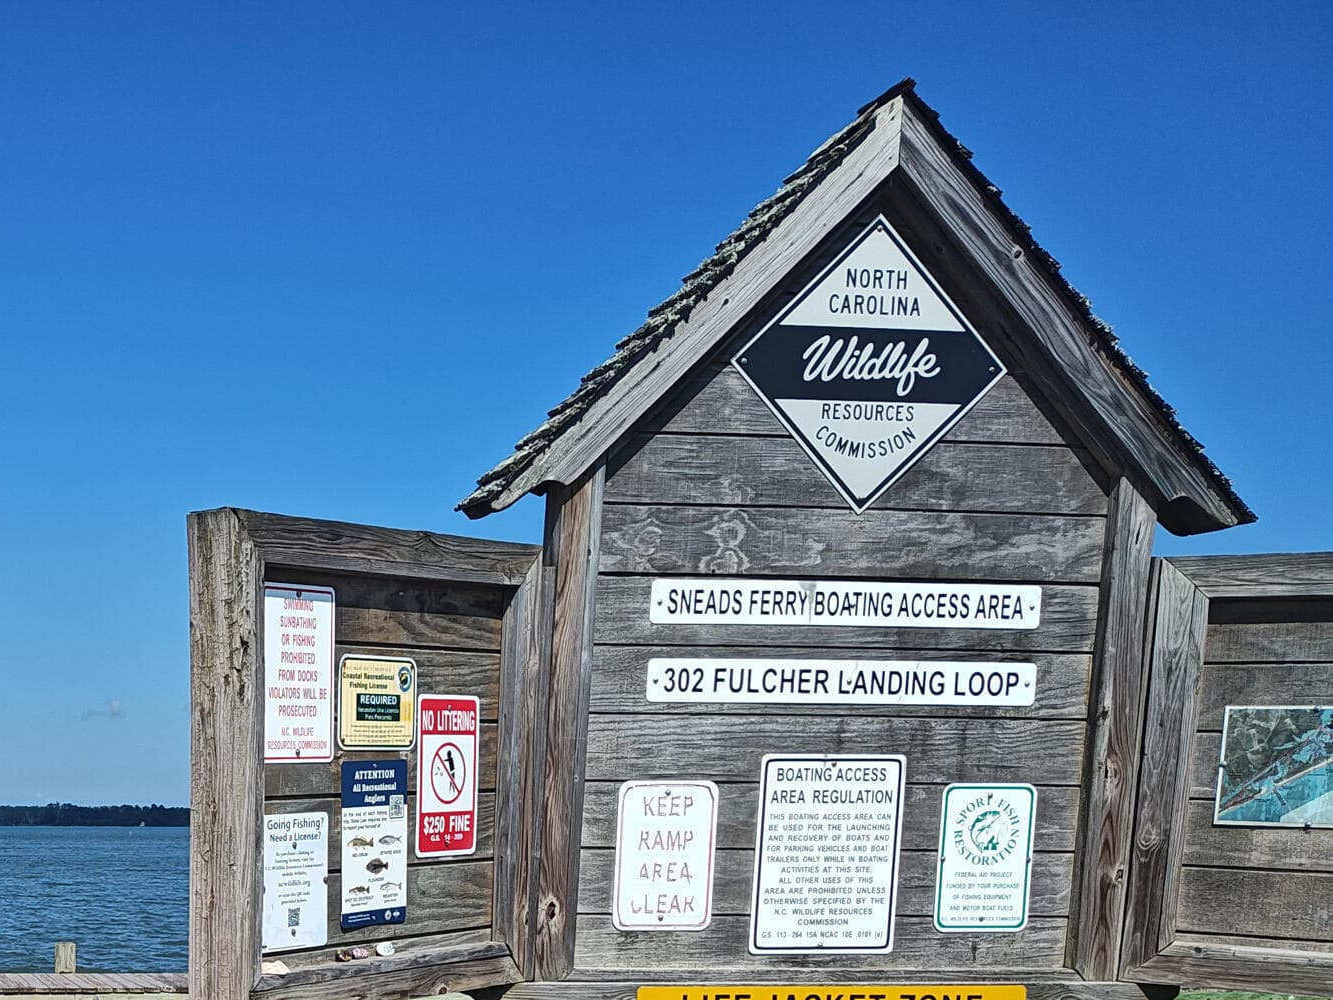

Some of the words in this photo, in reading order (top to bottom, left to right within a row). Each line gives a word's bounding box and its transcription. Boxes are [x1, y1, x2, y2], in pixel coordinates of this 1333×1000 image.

[846, 268, 908, 290] NORTH
[829, 294, 921, 317] CAROLINA
[802, 335, 941, 396] Wildlife
[821, 403, 914, 422] RESOURCES
[815, 425, 916, 459] COMMISSION
[284, 598, 314, 612] SWIMMING
[667, 589, 742, 615] SNEADS
[749, 590, 808, 616] FERRY
[813, 591, 893, 618] BOATING
[897, 593, 970, 619] ACCESS
[974, 594, 1024, 620] AREA
[280, 615, 317, 629] SUNBATHING
[281, 633, 290, 646] OR
[293, 634, 316, 647] FISHING
[281, 651, 316, 664] PROHIBITED
[278, 669, 296, 682] FROM
[298, 670, 318, 682] DOCKS
[342, 672, 362, 680] Coastal
[364, 673, 395, 681] Recreational
[664, 668, 704, 693] 302
[713, 668, 828, 694] FULCHER
[837, 670, 945, 696] LANDING
[954, 671, 1019, 697] LOOP
[349, 682, 367, 690] Fishing
[268, 687, 301, 699] VIOLATORS
[303, 688, 317, 699] WILL
[319, 688, 327, 700] BE
[360, 695, 397, 705] REQUIRED
[279, 705, 317, 717] PROSECUTED
[422, 710, 435, 731] NO
[437, 710, 475, 731] LITTERING
[293, 727, 314, 736] WILDLIFE
[267, 740, 296, 750] RESOURCES
[298, 740, 327, 750] COMMISSION
[354, 769, 395, 780] ATTENTION
[777, 768, 832, 781] BOATING
[835, 768, 887, 781] ACCESS
[353, 783, 361, 793] All
[362, 782, 397, 792] Recreational
[771, 790, 805, 804] AREA
[813, 790, 893, 804] REGULATION
[644, 796, 693, 816] KEEP
[956, 797, 992, 826] SPORT
[997, 799, 1020, 825] FISH
[267, 819, 291, 831] Going
[293, 817, 324, 831] Fishing?
[423, 815, 445, 836] $250
[449, 815, 470, 832] FINE
[270, 834, 287, 842] Need
[294, 832, 322, 842] License?
[638, 830, 694, 851] RAMP
[954, 828, 1020, 866] RESTORATION
[639, 862, 693, 884] AREA
